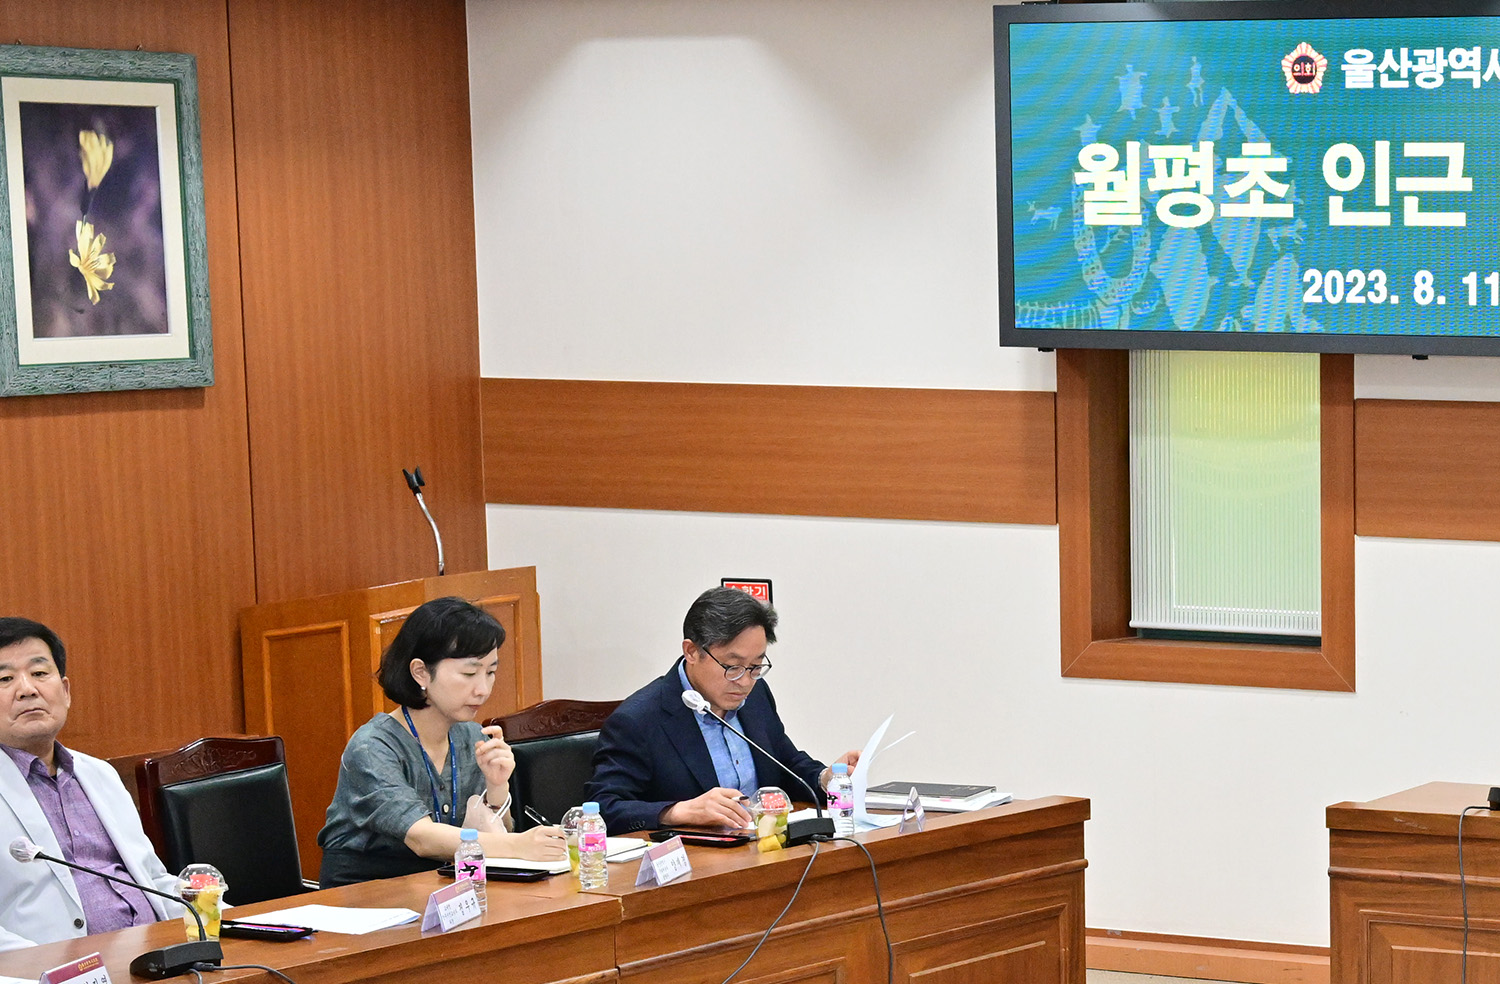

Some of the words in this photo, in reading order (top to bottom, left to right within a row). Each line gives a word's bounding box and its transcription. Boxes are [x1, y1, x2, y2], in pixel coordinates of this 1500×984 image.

[1073, 141, 1296, 230] 월평초
[1322, 141, 1475, 228] 인근
[1302, 269, 1401, 305] 2023.
[1413, 271, 1448, 306] 8.
